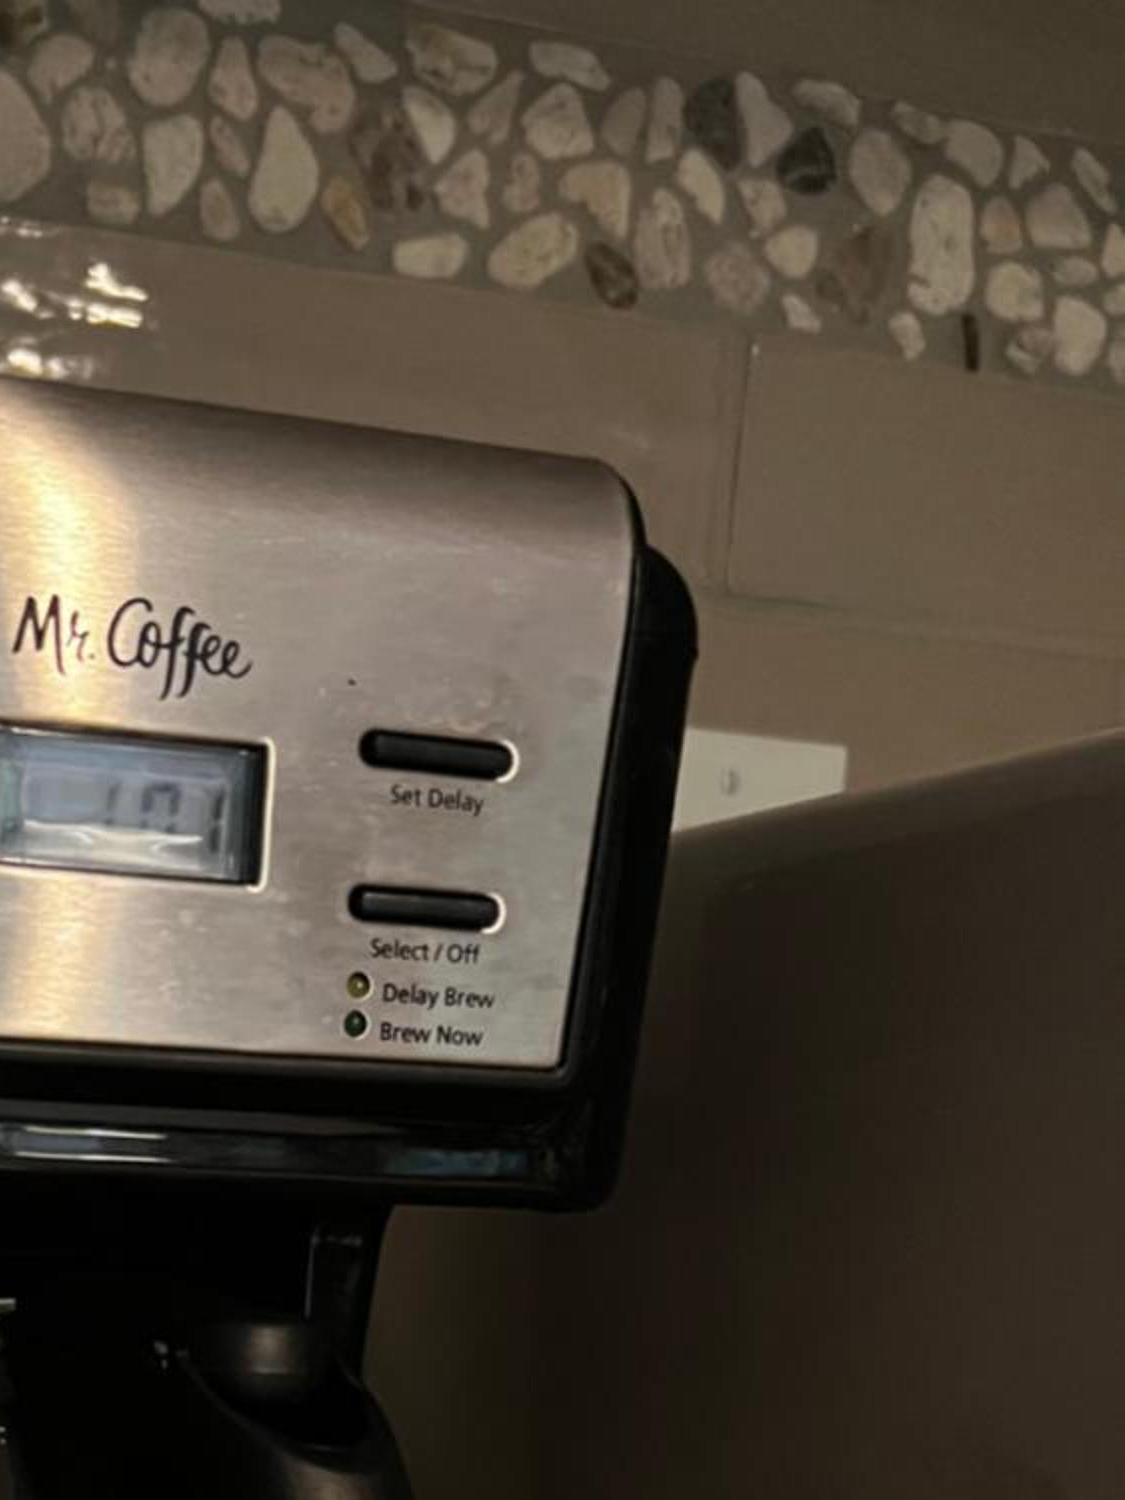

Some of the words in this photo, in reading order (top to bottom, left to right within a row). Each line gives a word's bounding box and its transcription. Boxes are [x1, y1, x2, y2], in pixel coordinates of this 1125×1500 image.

[11, 594, 95, 676] Mr.
[107, 597, 253, 700] Coffee
[390, 784, 422, 806] Set
[428, 788, 485, 816] Delay
[370, 938, 429, 961] Select
[447, 946, 481, 964] Off
[382, 984, 439, 1010] Delay
[444, 987, 496, 1008] Brew
[379, 1022, 430, 1042] Brew
[437, 1025, 484, 1046] Now
